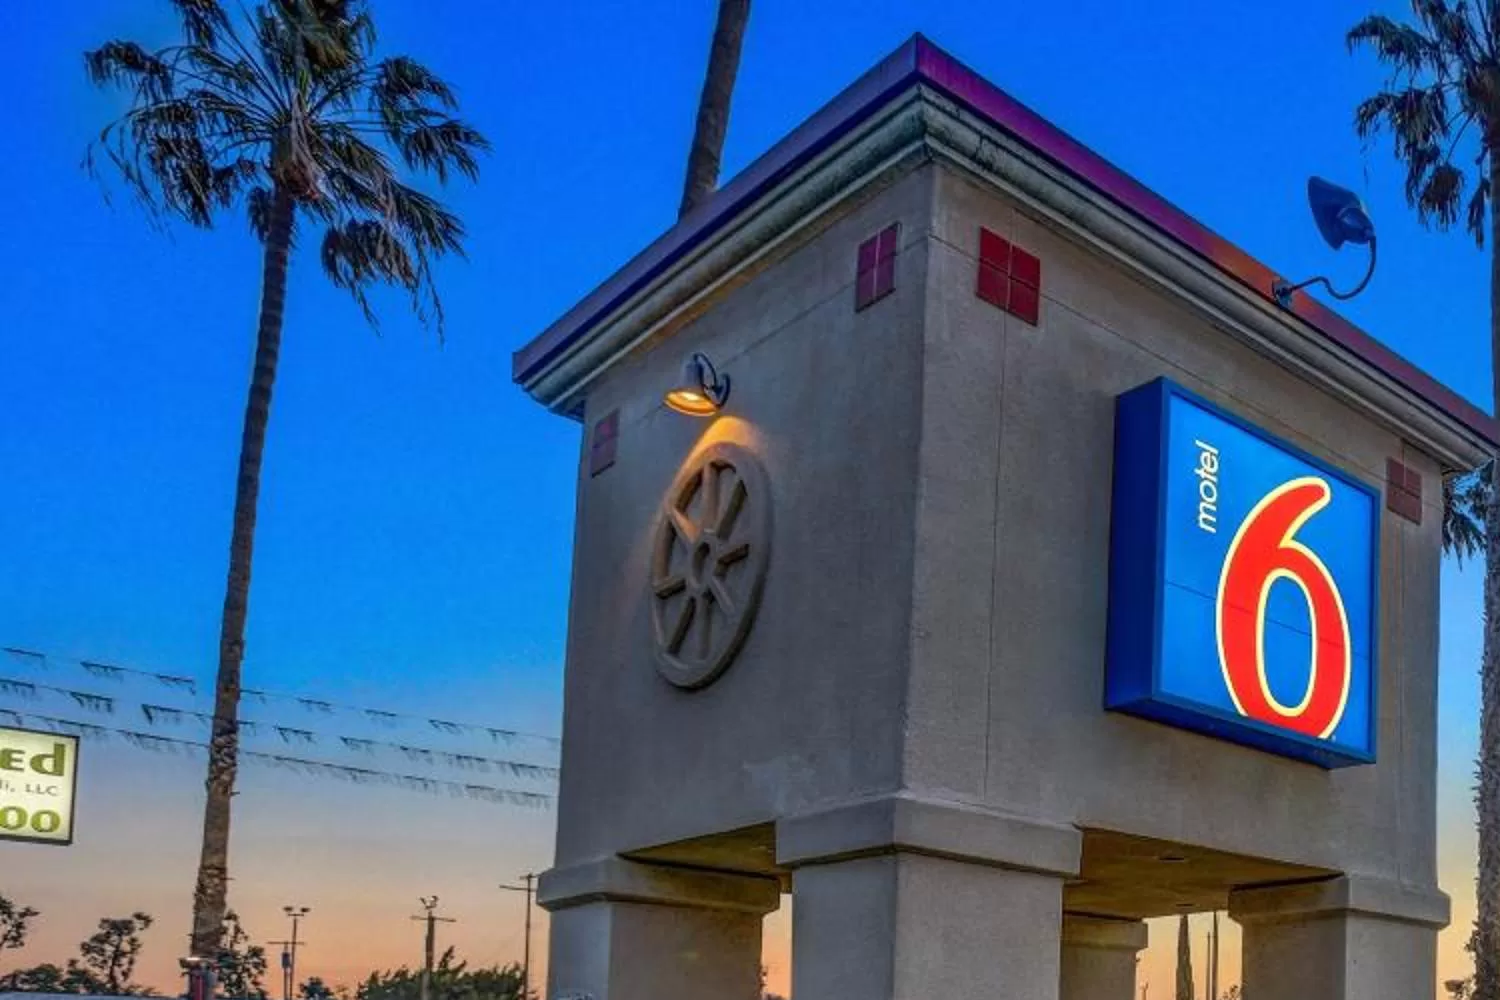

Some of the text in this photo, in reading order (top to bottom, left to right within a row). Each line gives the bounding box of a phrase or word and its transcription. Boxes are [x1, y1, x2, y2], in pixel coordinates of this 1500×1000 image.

[1194, 439, 1351, 739] motel 6
[25, 783, 59, 797] LLC
